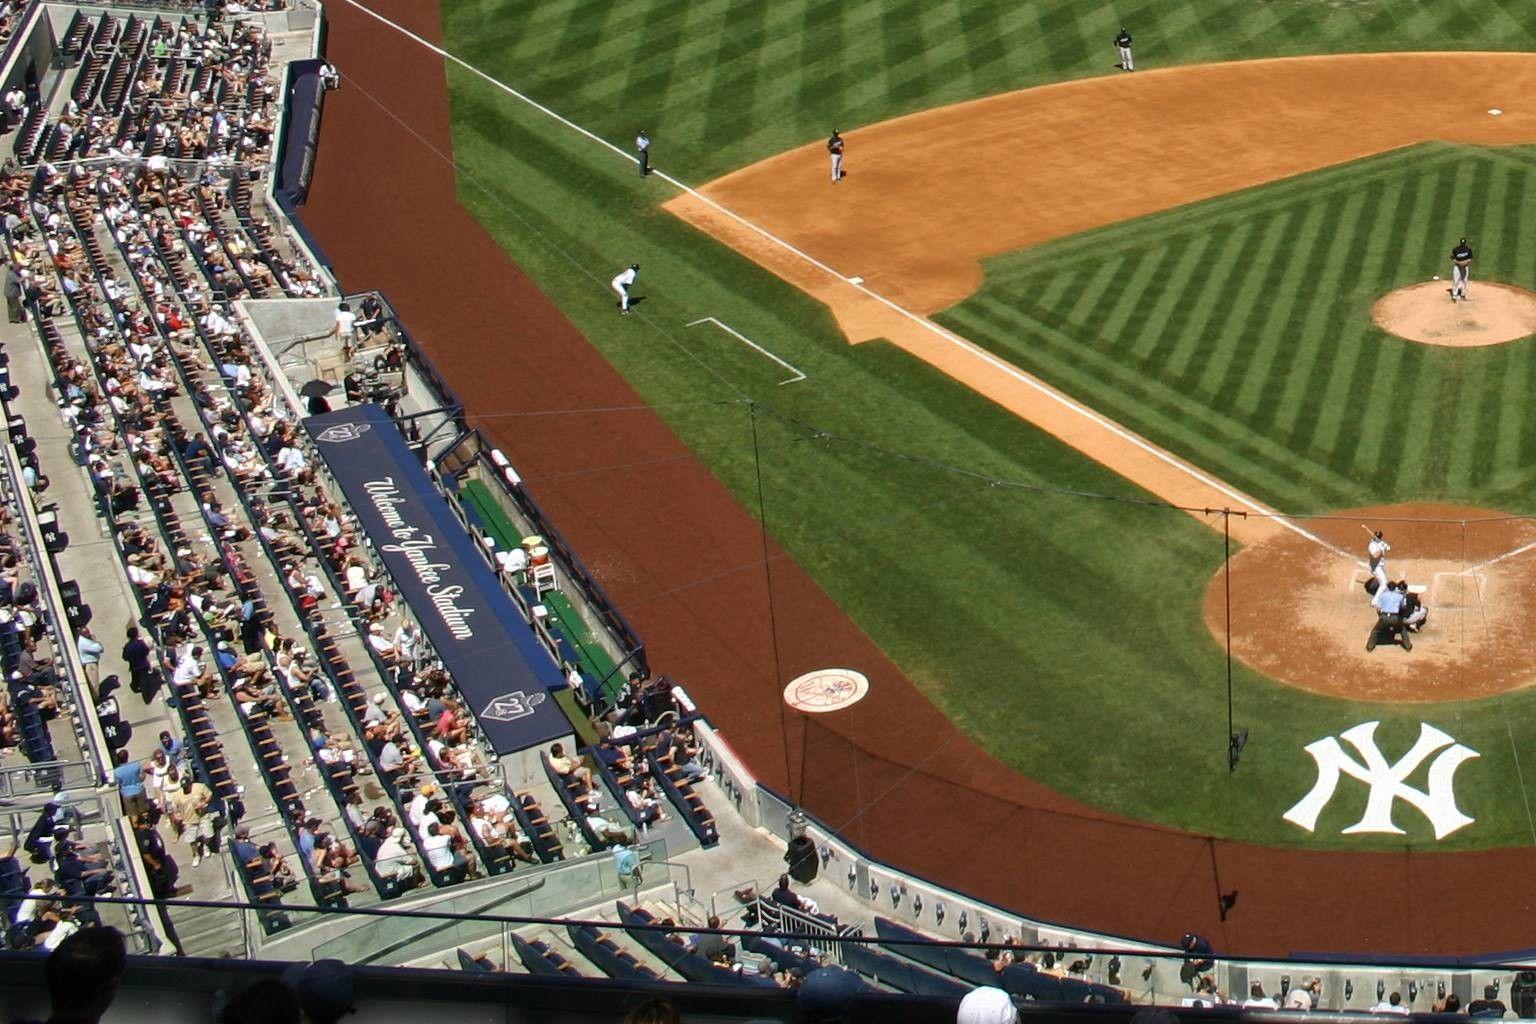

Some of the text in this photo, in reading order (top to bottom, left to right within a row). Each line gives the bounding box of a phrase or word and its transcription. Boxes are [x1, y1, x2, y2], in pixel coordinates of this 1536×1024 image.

[363, 476, 475, 641] Welcome to Yankee Stadium
[1282, 720, 1481, 841] NY
